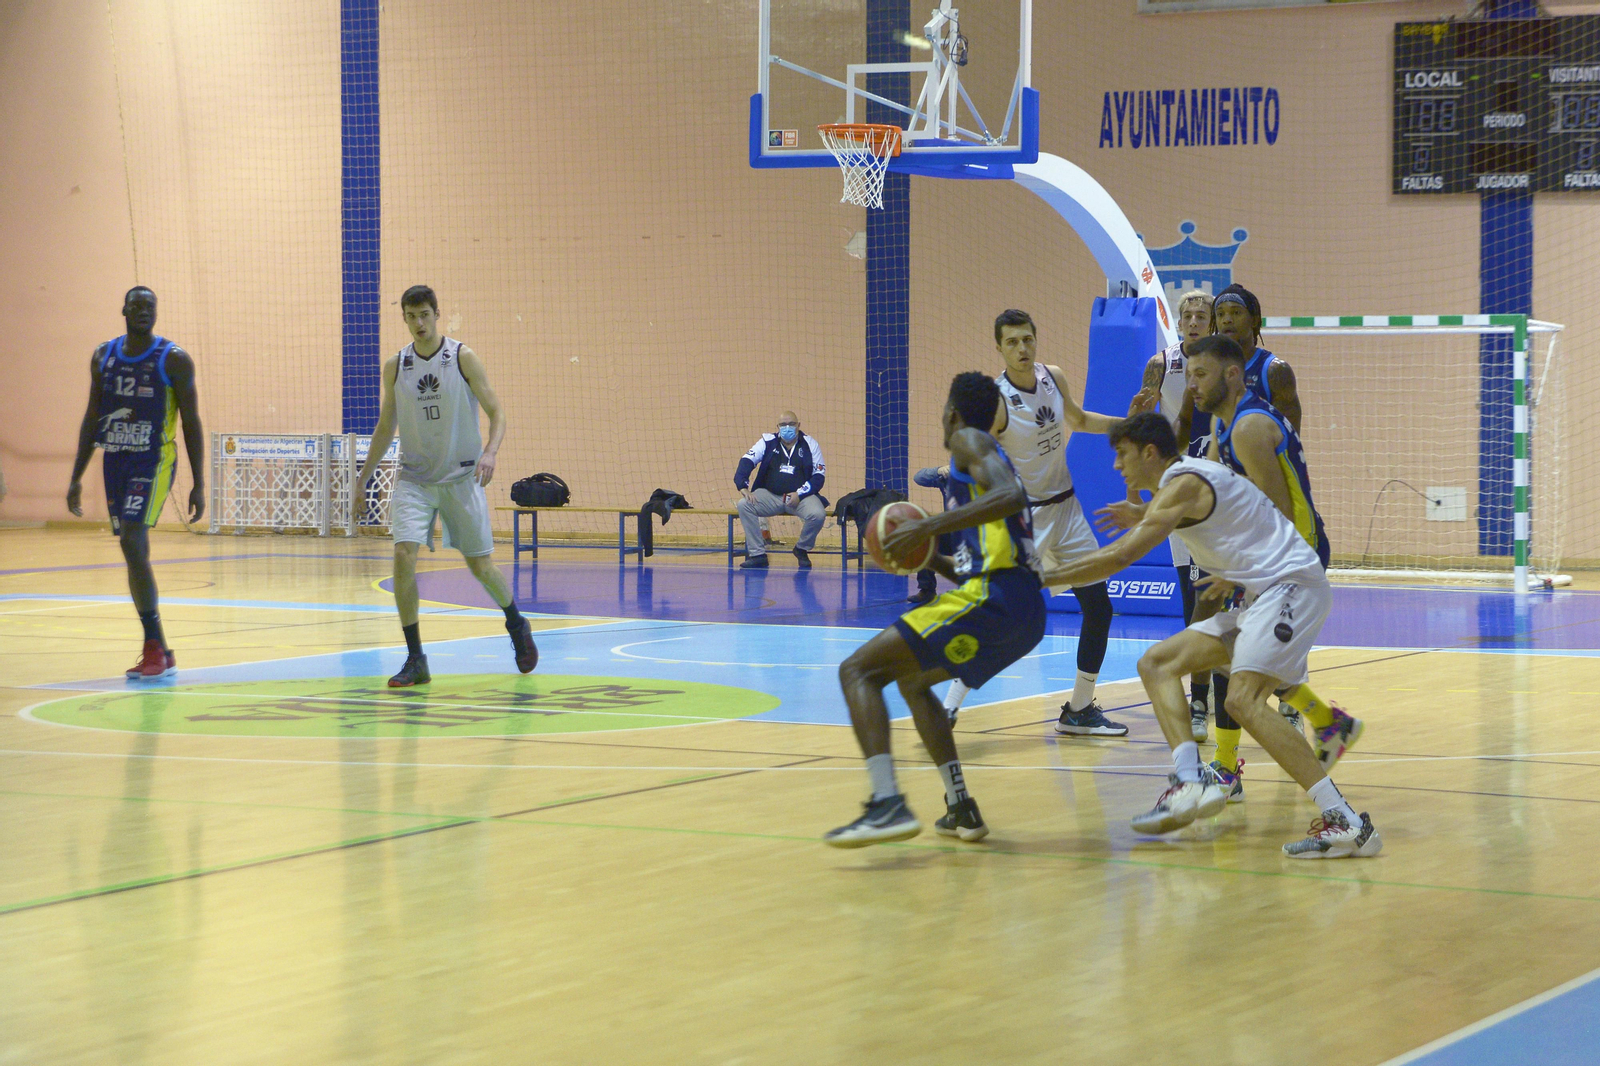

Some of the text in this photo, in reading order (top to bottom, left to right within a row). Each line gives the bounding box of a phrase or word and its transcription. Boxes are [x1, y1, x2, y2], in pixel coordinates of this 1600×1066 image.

[1405, 71, 1463, 88] LOCAL
[1099, 86, 1280, 149] AYUNTAMIENTO
[1483, 113, 1526, 128] PERIODO
[1402, 176, 1443, 190] FALTAS
[1476, 174, 1530, 189] JUGADOR
[115, 375, 136, 397] 12
[418, 394, 441, 402] HUAWEI
[423, 405, 440, 420] 10
[114, 421, 152, 435] ENER
[107, 431, 151, 445] DRINK
[238, 437, 272, 445] Ayuntamiento
[1037, 431, 1061, 457] 33
[240, 447, 300, 456] Delegación de Deportes
[125, 495, 144, 510] 12
[1106, 580, 1176, 597] SYSTEM
